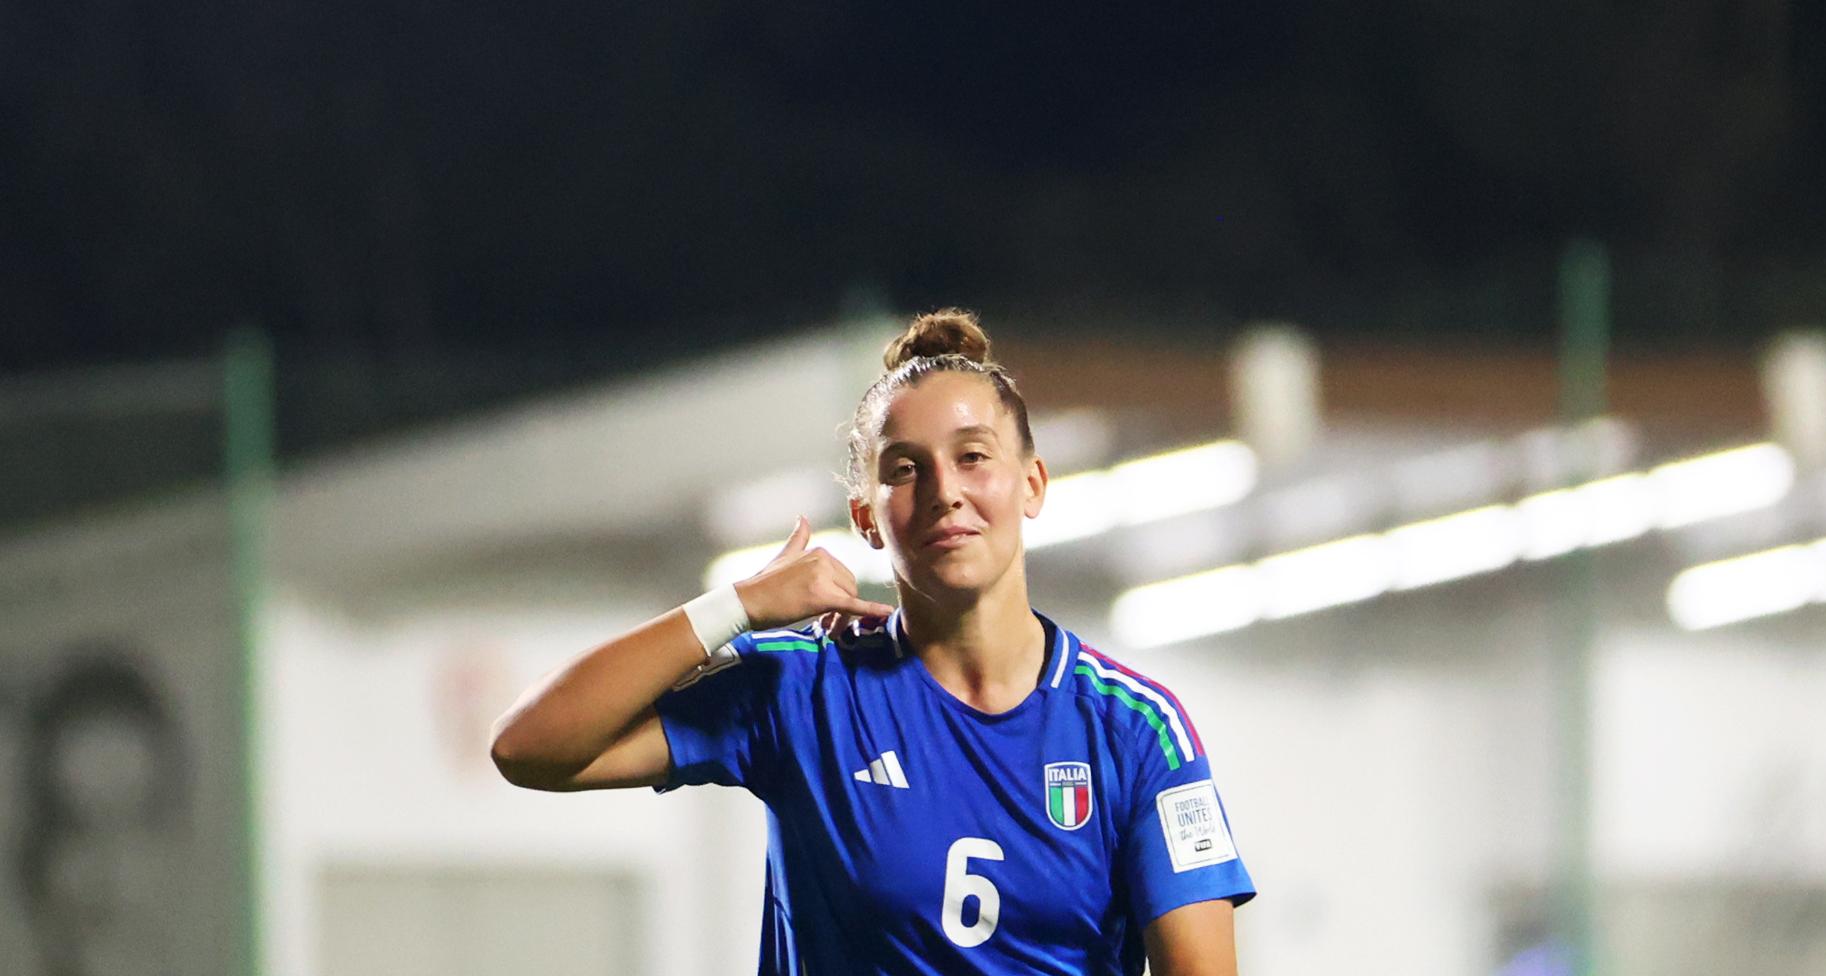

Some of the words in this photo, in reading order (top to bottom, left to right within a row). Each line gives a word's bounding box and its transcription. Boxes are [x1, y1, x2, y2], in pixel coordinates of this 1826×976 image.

[1048, 766, 1087, 782] ITALIA
[1177, 807, 1213, 828] UNITES
[942, 837, 1005, 948] 6
